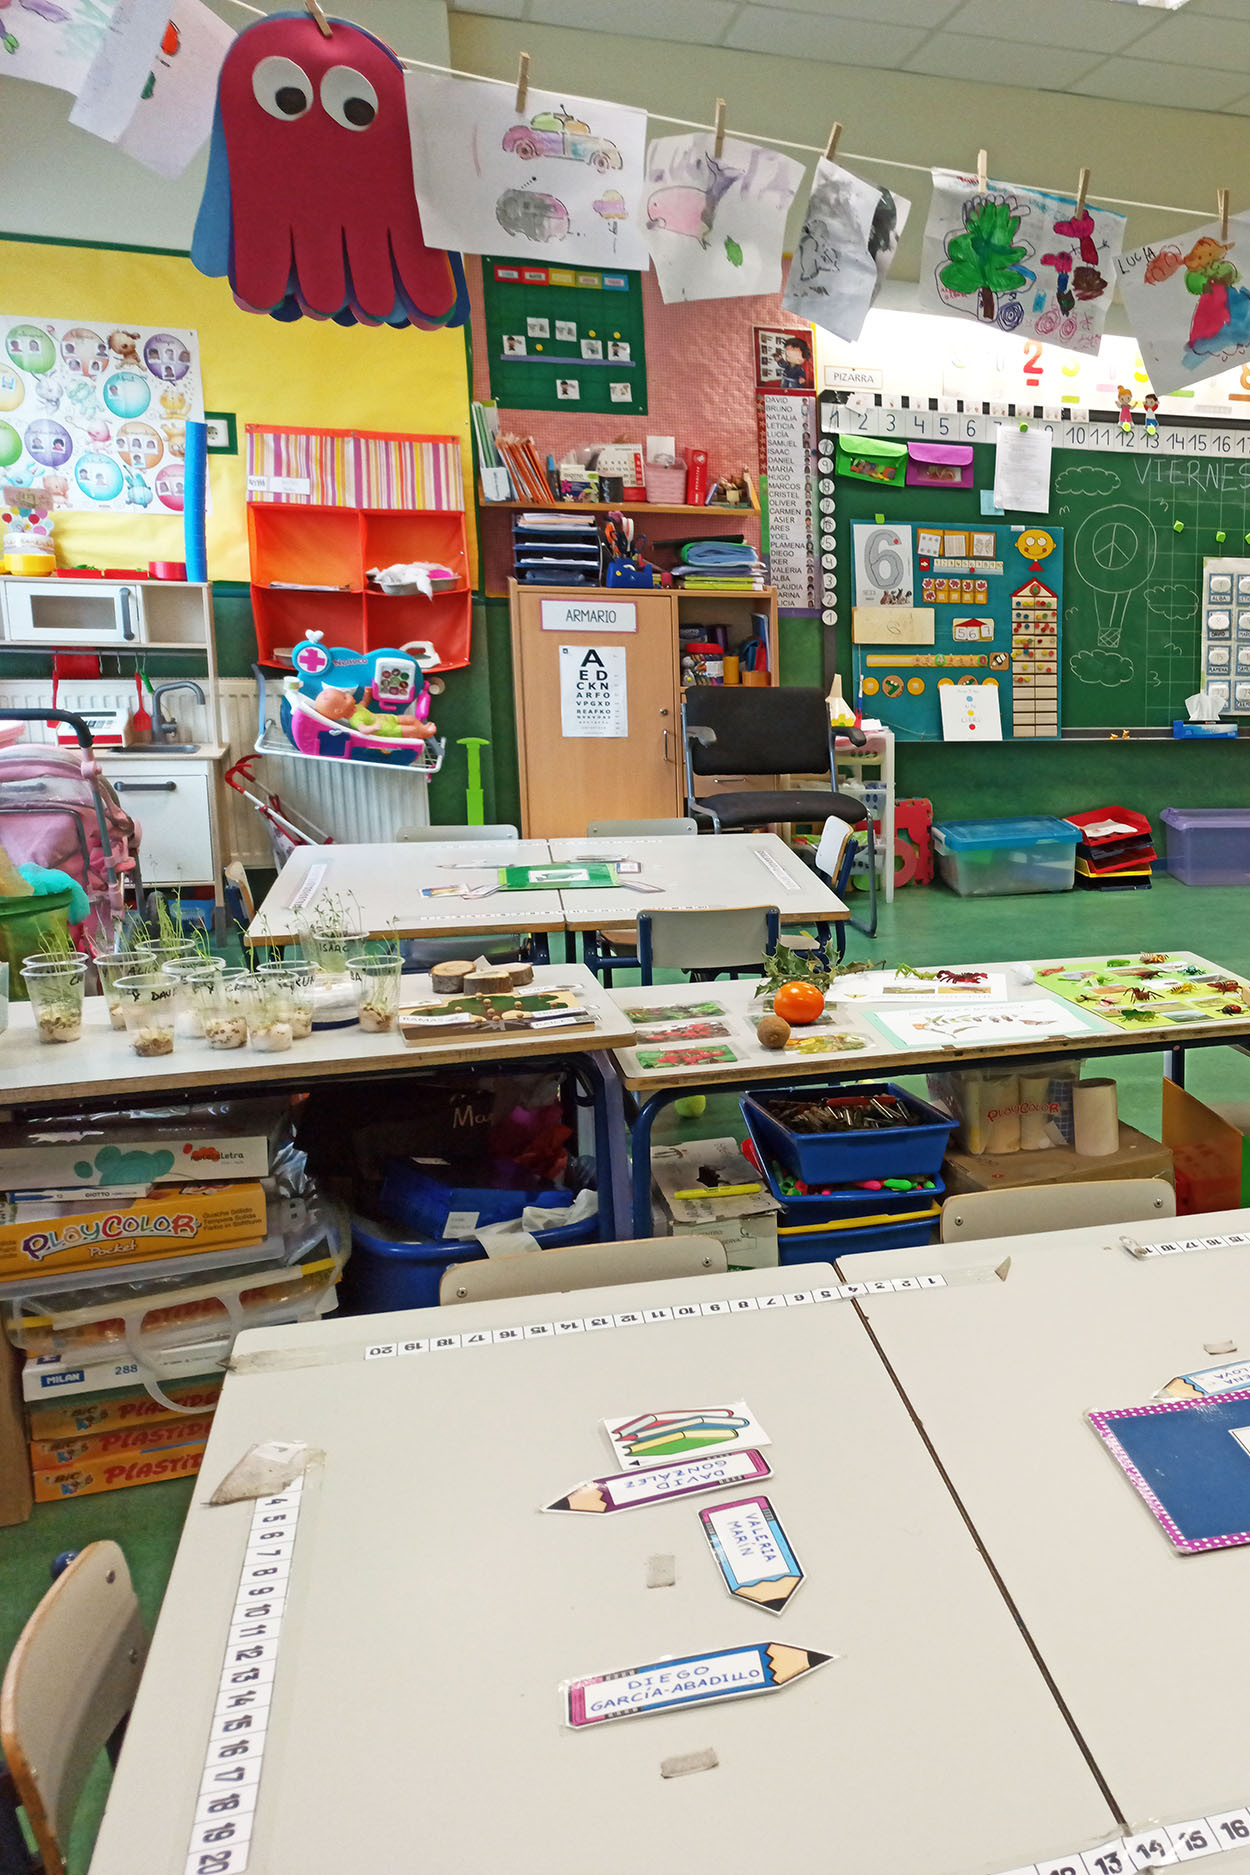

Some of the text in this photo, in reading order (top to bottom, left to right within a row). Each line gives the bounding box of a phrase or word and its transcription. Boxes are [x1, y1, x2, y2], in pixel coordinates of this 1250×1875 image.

[1023, 339, 1044, 373] 2
[833, 372, 875, 385] PIZARRA
[886, 414, 897, 432] 3
[914, 416, 926, 434] 4
[939, 417, 950, 436] 5
[966, 419, 976, 438] 6
[1066, 427, 1086, 445] 10
[1188, 434, 1207, 452] 15
[864, 529, 904, 591] 6
[566, 609, 617, 623] ARMARIO
[580, 649, 605, 667] A
[90, 1239, 137, 1258] Pocket
[46, 1364, 138, 1385] MILAN 288
[656, 1469, 726, 1490] DAVID
[726, 1520, 755, 1557] MARÍN
[745, 1512, 777, 1563] VALERIA
[590, 1668, 761, 1712] GARCÍA-ABADILLO
[628, 1666, 710, 1691] DIEGO
[208, 1603, 271, 1814] 10 12 15 18
[1220, 1820, 1250, 1840] 16
